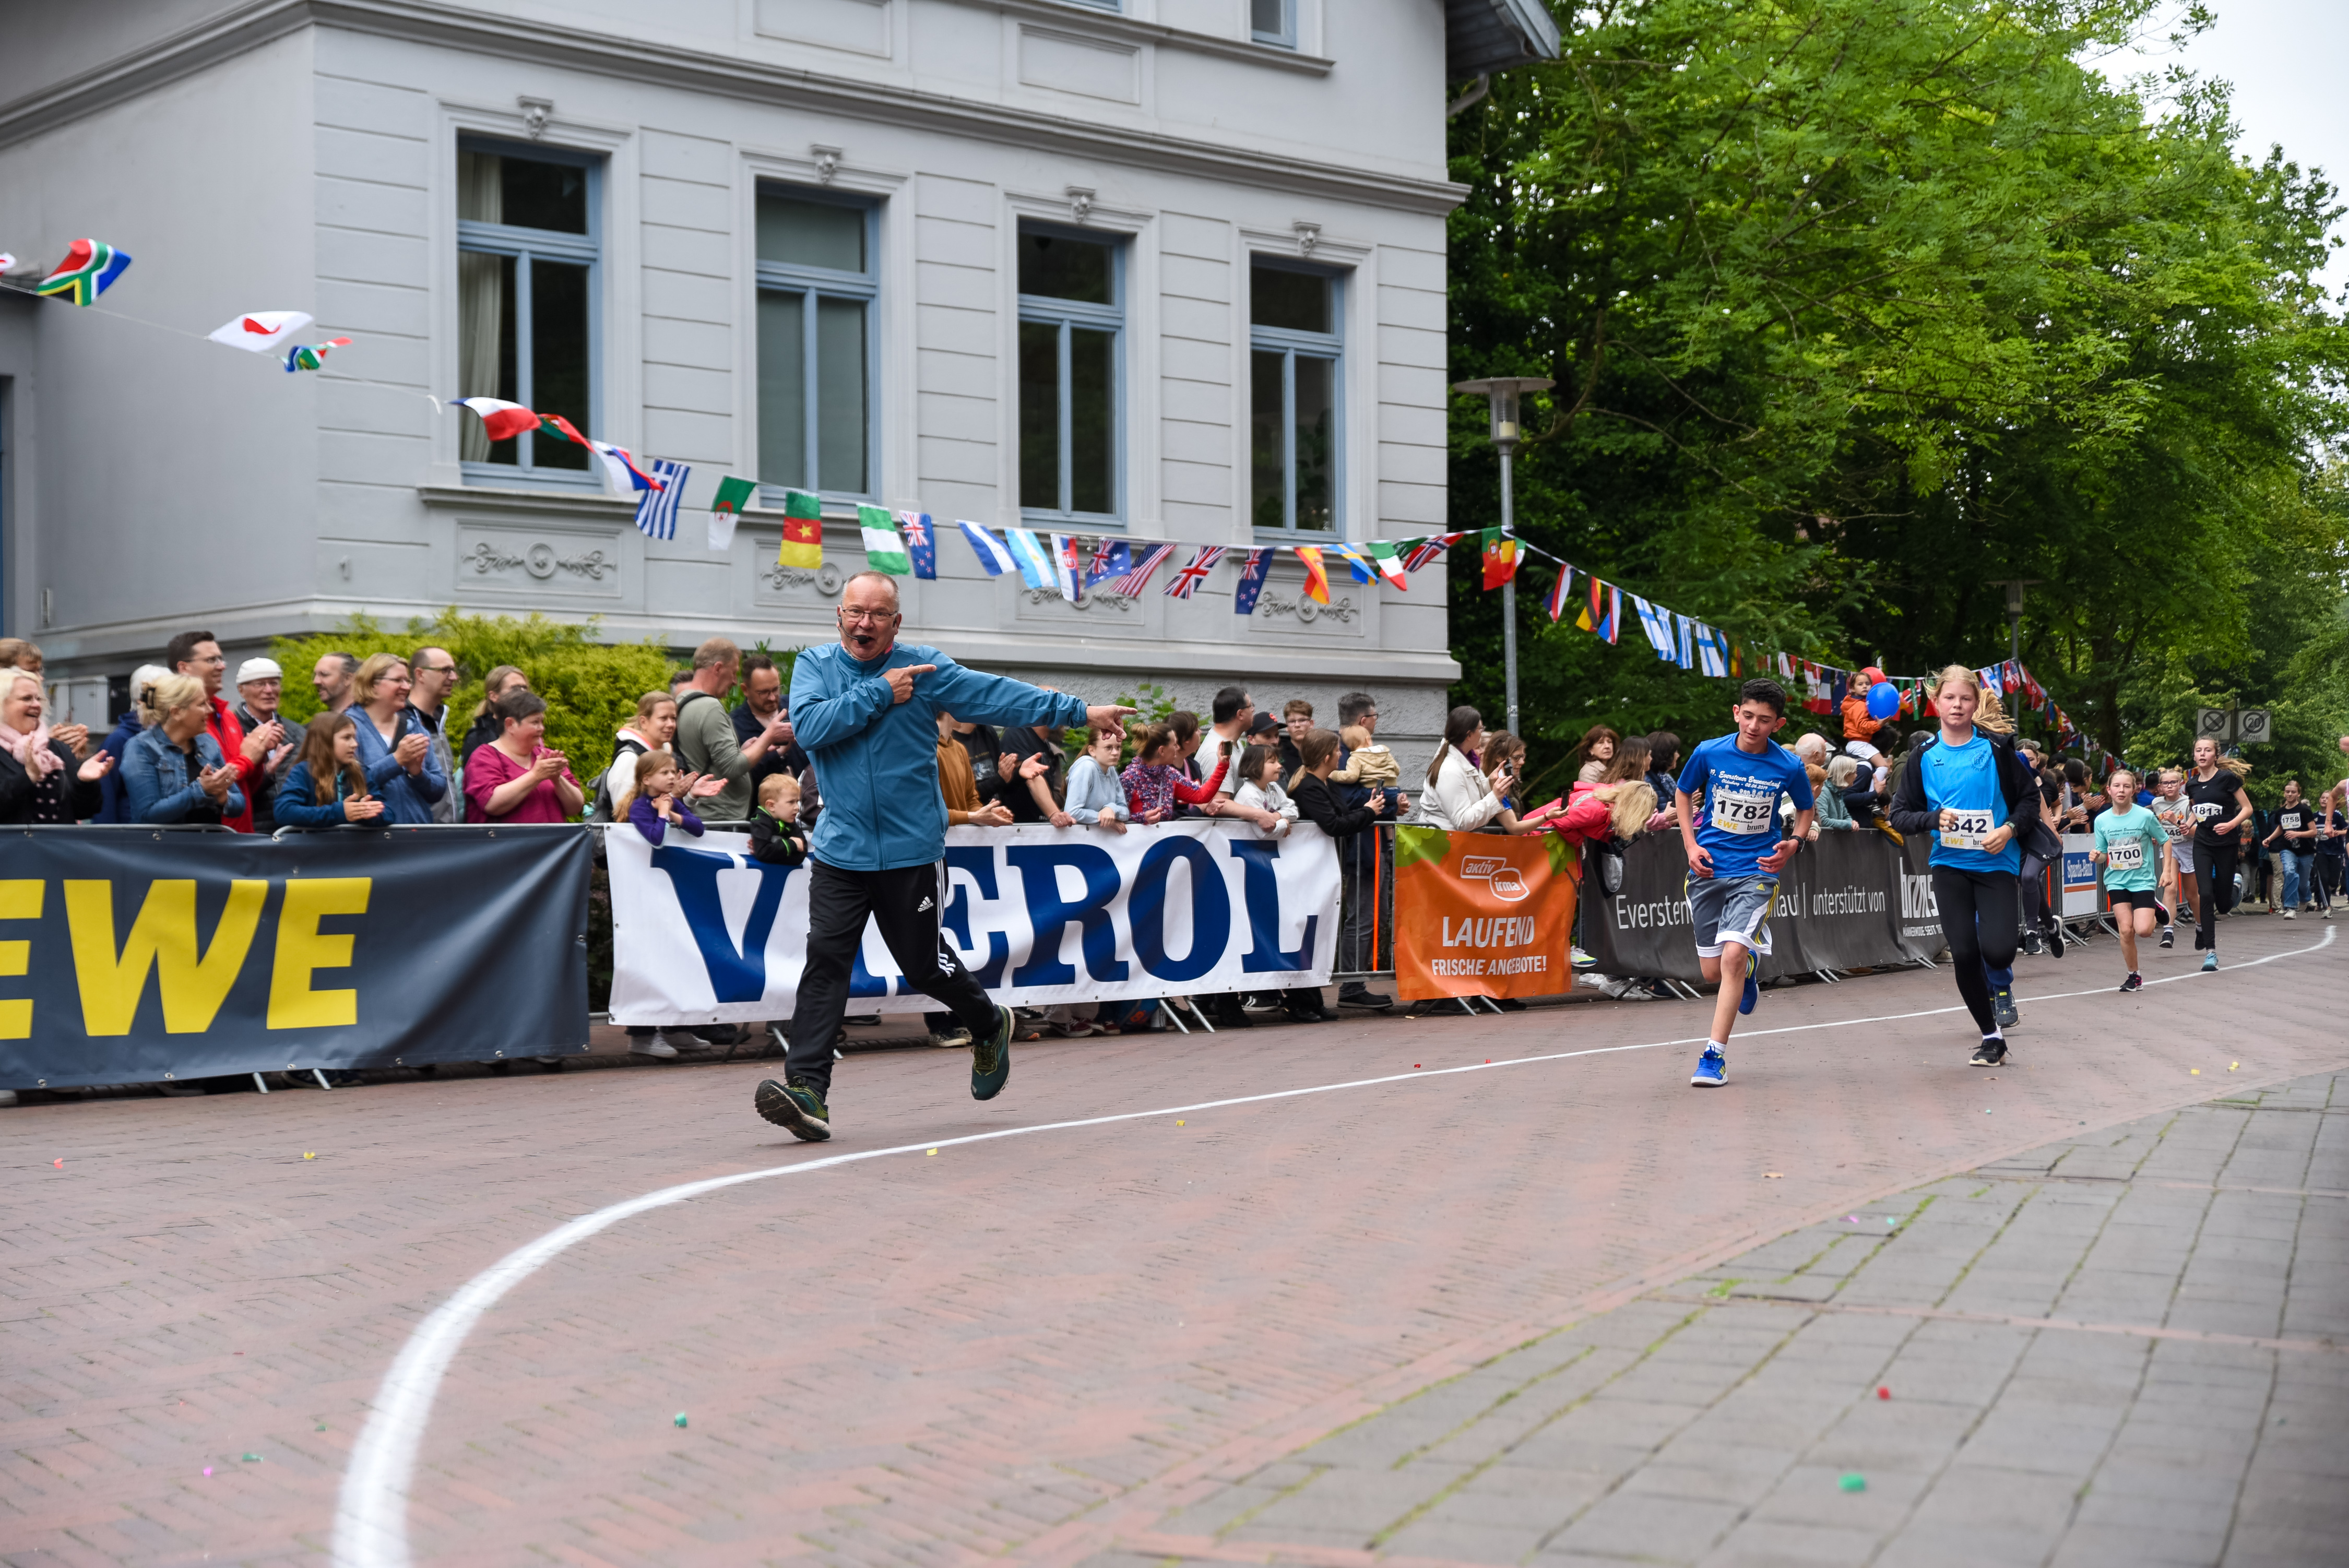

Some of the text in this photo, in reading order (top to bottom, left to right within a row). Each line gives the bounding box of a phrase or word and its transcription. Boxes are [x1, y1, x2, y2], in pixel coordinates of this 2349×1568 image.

[2248, 718, 2261, 729] 20
[1718, 770, 1747, 782] Everstener
[1748, 776, 1781, 789] Brunnenlauf
[1719, 794, 1743, 803] Everstener
[1717, 800, 1771, 820] 1782
[2193, 806, 2221, 815] 1813
[1717, 818, 1739, 830] EWE
[1945, 837, 1965, 845] EWE
[2109, 849, 2141, 861] 1700
[1465, 860, 1495, 874] aktiv
[2067, 859, 2093, 883] Sparda-Bank
[1494, 877, 1521, 892] irma
[1900, 857, 1939, 919] bruns
[918, 902, 934, 912] adidas
[1616, 895, 1693, 930] Eversten
[1813, 885, 1867, 916] unterstützt
[1868, 891, 1886, 912] von
[650, 835, 1318, 1003] VEROL
[1443, 916, 1535, 948] LAUFEND
[1431, 955, 1547, 976] FRISCHE ANGEBOTE!
